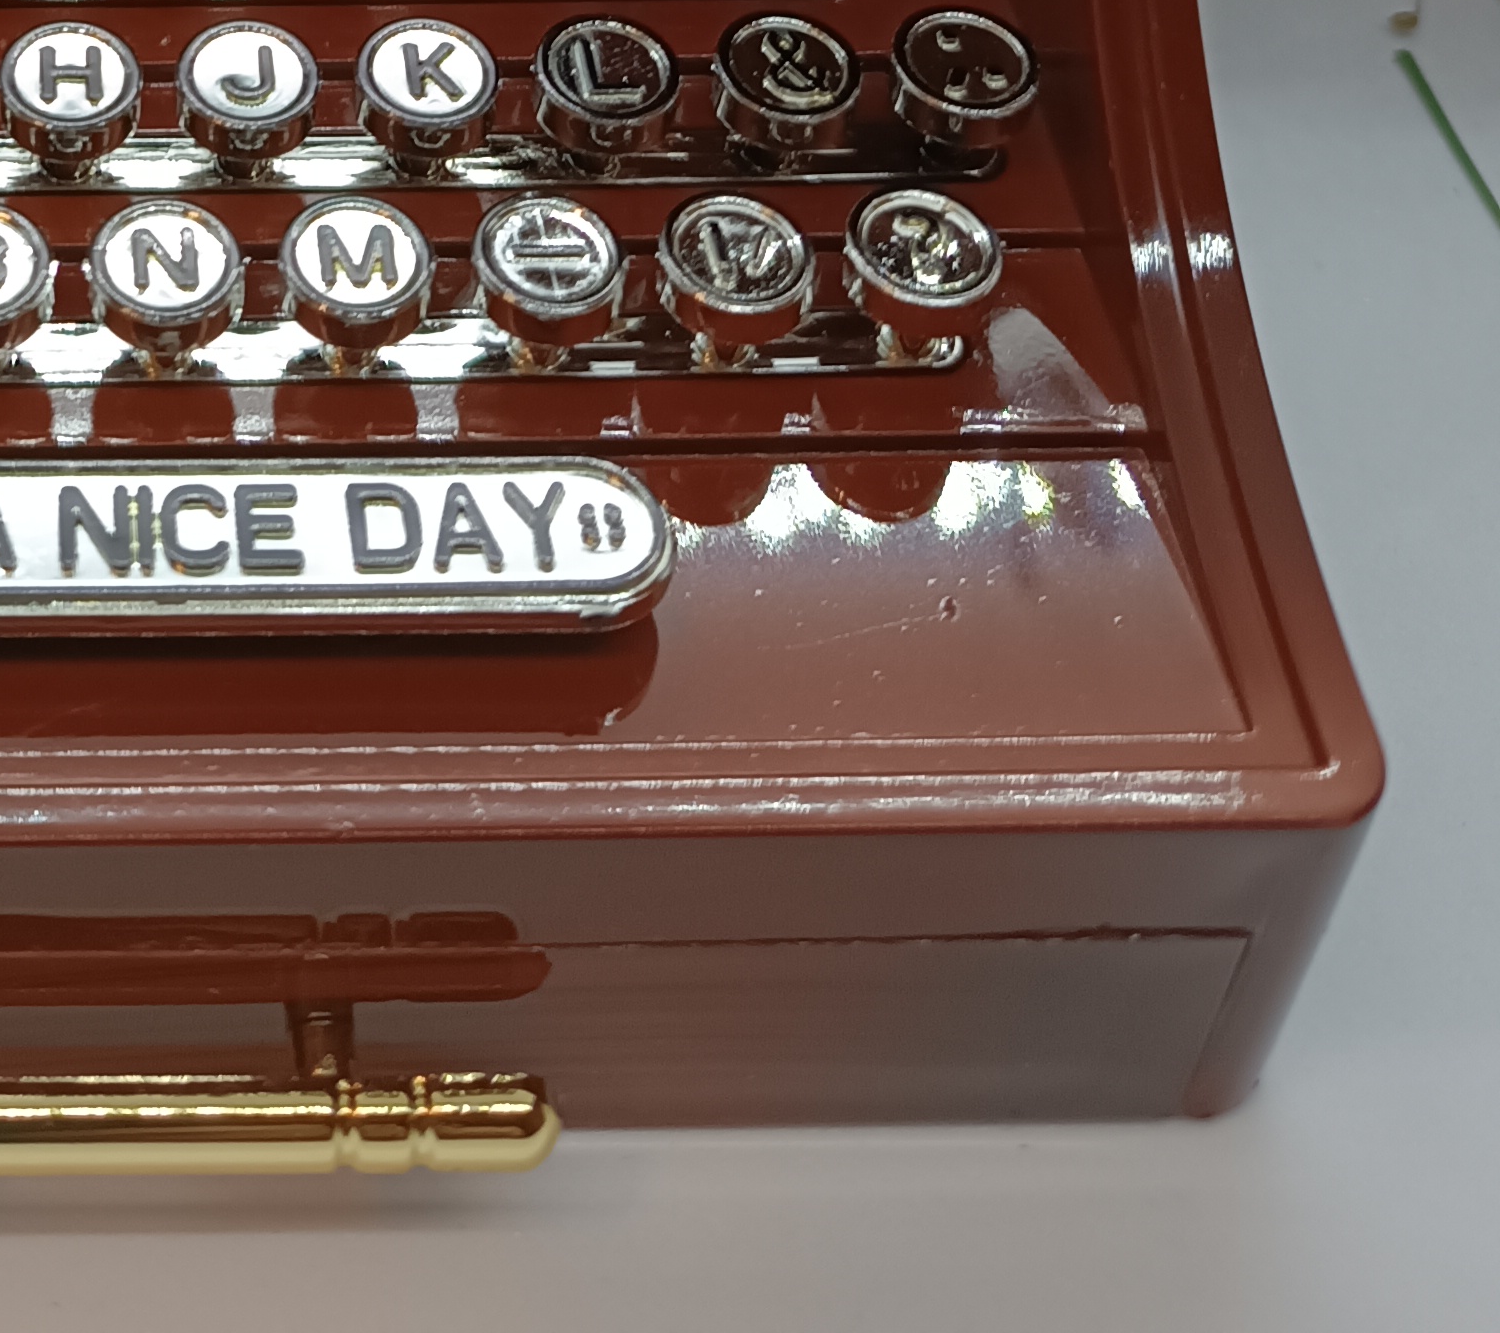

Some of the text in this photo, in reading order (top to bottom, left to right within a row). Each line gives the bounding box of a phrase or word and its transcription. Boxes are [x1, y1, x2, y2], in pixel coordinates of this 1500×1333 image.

[37, 44, 101, 106] H
[216, 44, 277, 108] J
[400, 40, 466, 104] K
[570, 35, 647, 102] L
[130, 225, 201, 295] N
[316, 223, 397, 294] M
[60, 483, 300, 577] NICE
[345, 481, 566, 574] DAY
